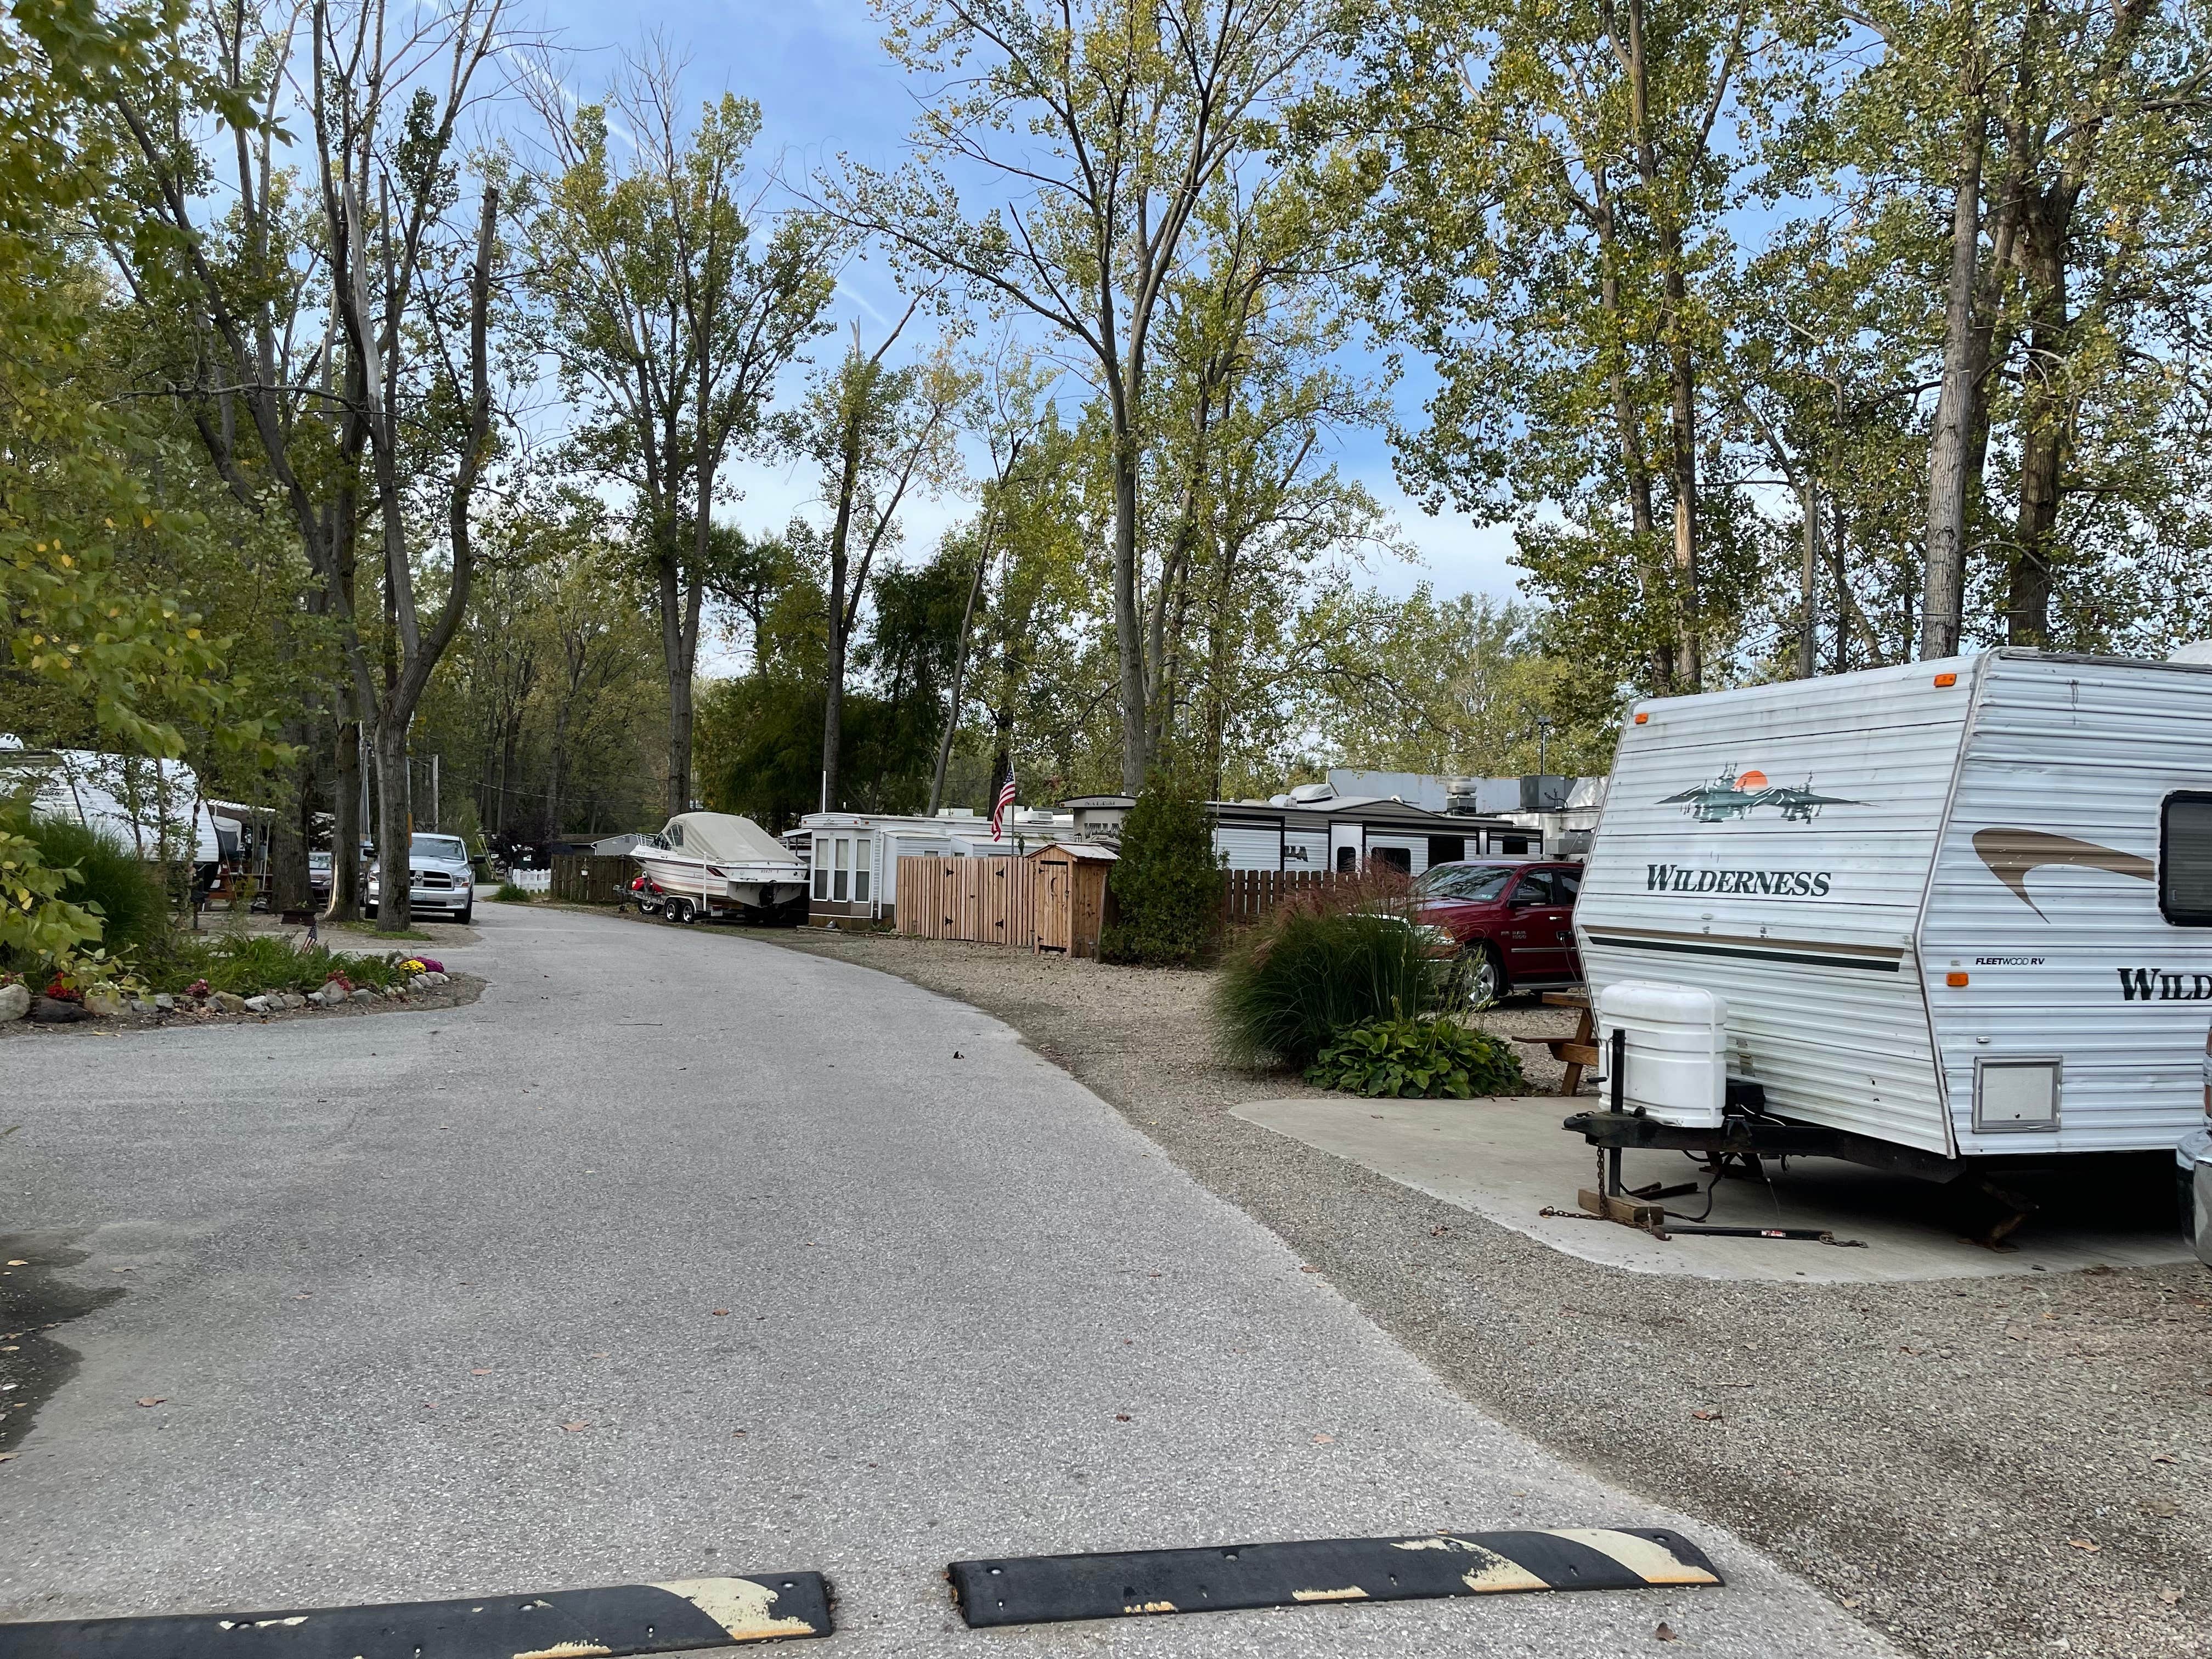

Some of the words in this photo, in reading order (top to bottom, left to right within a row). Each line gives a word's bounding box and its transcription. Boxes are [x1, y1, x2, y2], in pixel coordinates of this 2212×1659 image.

[1084, 823, 1121, 839] VILLA
[1284, 845, 1308, 862] LLA
[1647, 864, 1831, 896] WILDERNESS
